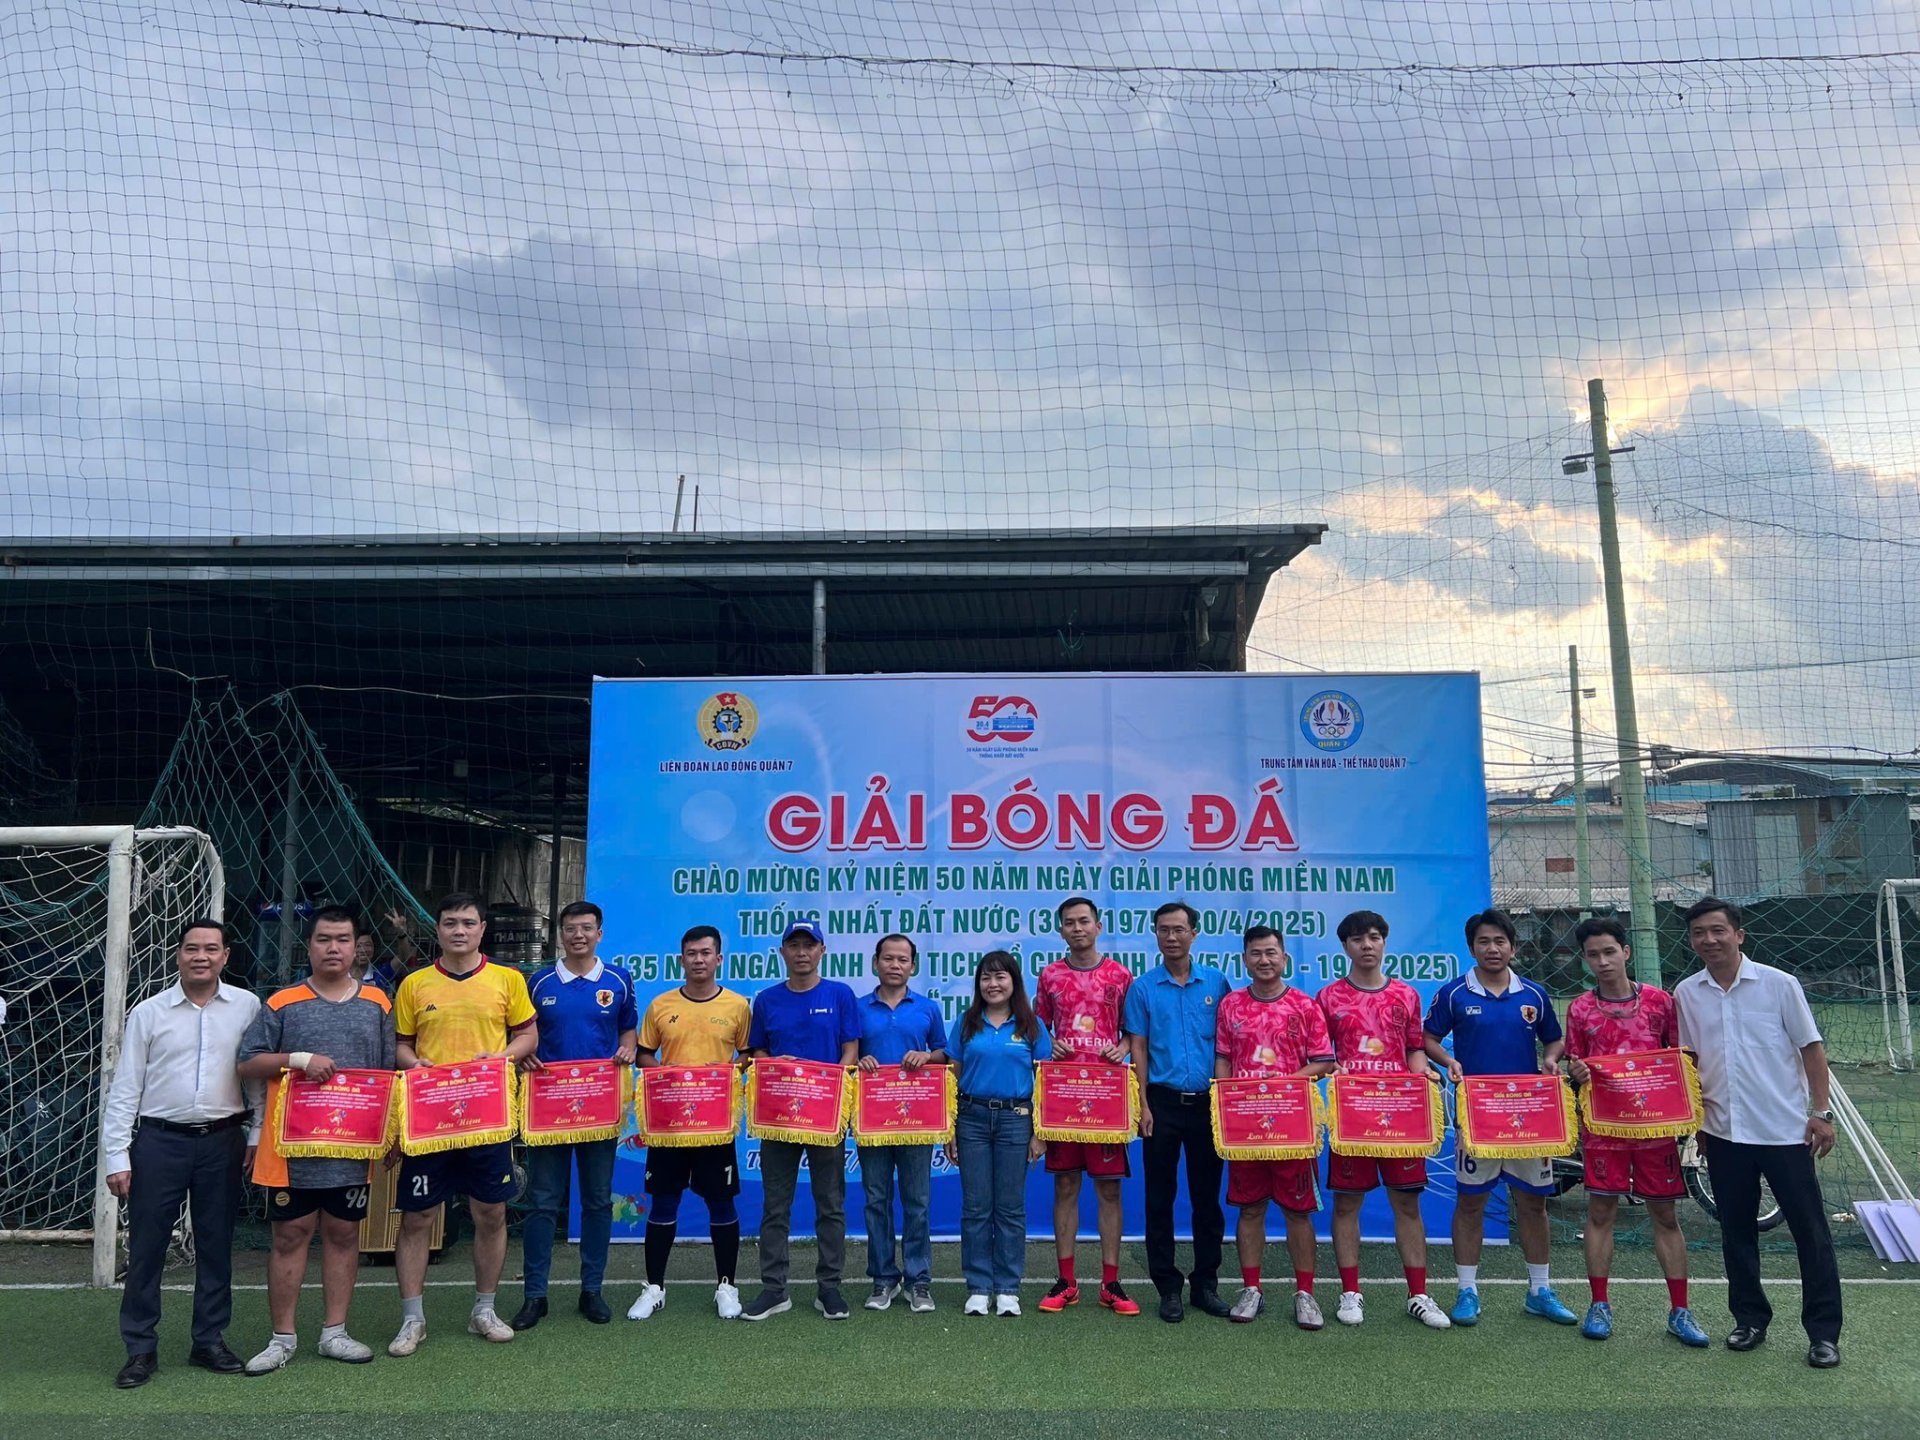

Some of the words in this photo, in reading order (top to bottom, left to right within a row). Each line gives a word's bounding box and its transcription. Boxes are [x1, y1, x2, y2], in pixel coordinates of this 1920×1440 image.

[660, 760, 681, 772] LIÊN
[684, 760, 709, 772] ĐOÀN
[712, 761, 728, 772] LAO
[731, 759, 757, 773] ĐỘNG
[759, 759, 785, 773] QUẬN
[788, 761, 793, 771] 7
[1261, 758, 1286, 769] TRUNG
[1287, 756, 1303, 769] TÂM
[1305, 757, 1320, 769] VĂN
[1343, 754, 1357, 769] THỂ
[1359, 758, 1377, 768] THAO
[1379, 756, 1401, 771] QUẬN
[1402, 758, 1407, 767] 7
[767, 774, 925, 851] GIẢI
[948, 776, 1168, 851] BÓNG
[1188, 776, 1299, 851] ĐÁ
[672, 861, 739, 895] CHÀO
[747, 860, 820, 893] MỪNG
[828, 859, 858, 893] KỶ
[865, 862, 928, 897] NIỆM
[936, 866, 966, 892] 50
[972, 860, 1028, 892] NĂM
[1036, 860, 1102, 892] NGÀY
[1110, 858, 1160, 893] GIẢI
[1168, 860, 1254, 893] PHÓNG
[1262, 859, 1328, 894] MIỀN
[1335, 866, 1395, 894] NAM
[828, 901, 892, 935] NHẤT
[899, 901, 945, 934] ĐẤT
[953, 903, 1020, 934] NƯỚC
[730, 948, 790, 979] NGÀ
[822, 952, 863, 977] INH
[927, 952, 982, 982] TỊCH
[710, 1017, 729, 1026] Grab
[1063, 1037, 1113, 1047] TTERIA
[1459, 1149, 1477, 1174] 16
[412, 1175, 428, 1196] 21
[724, 1165, 733, 1185] 1
[345, 1187, 368, 1208] 96
